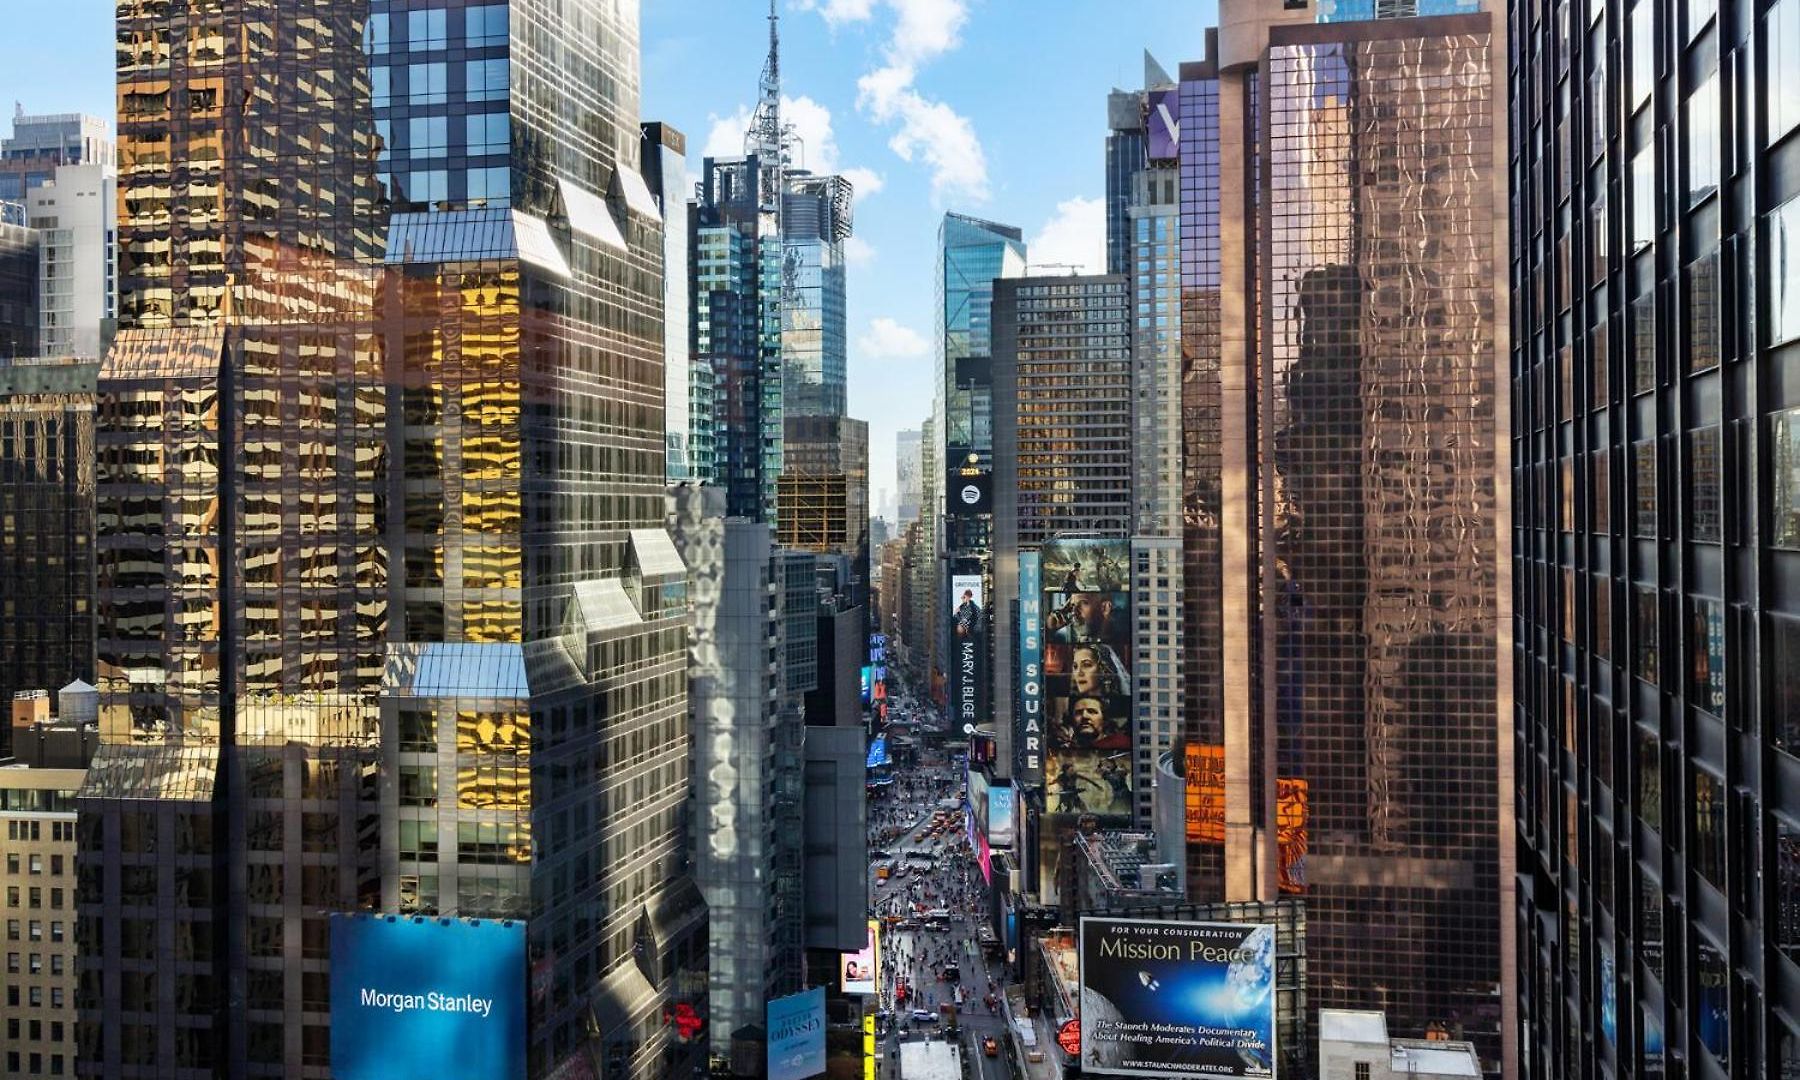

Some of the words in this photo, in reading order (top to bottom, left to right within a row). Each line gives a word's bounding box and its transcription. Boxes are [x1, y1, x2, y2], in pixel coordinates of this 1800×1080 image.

[1023, 564, 1039, 650] TIMES
[961, 642, 975, 675] MARY
[962, 686, 975, 718] BLIGE
[1024, 663, 1040, 769] SQUARE
[1111, 926, 1129, 934] FOR
[1134, 927, 1159, 936] YOUR
[1163, 928, 1243, 939] CONSIDERATION
[1100, 937, 1180, 960] Mission
[1190, 941, 1255, 964] Peace
[361, 988, 425, 1012] Morgan
[427, 992, 493, 1017] Stanley
[1092, 1032, 1118, 1041] About
[1120, 1033, 1153, 1044] Healing
[1155, 1035, 1197, 1045] America's
[1200, 1037, 1234, 1048] Political
[1237, 1039, 1266, 1050] Divide
[1097, 1021, 1113, 1029] The
[1115, 1021, 1149, 1031] Staunch
[1151, 1024, 1195, 1034] Moderates
[1198, 1026, 1257, 1039] Documentary
[1122, 1060, 1233, 1073] WWW.STAUNCHMODERATES.ORG
